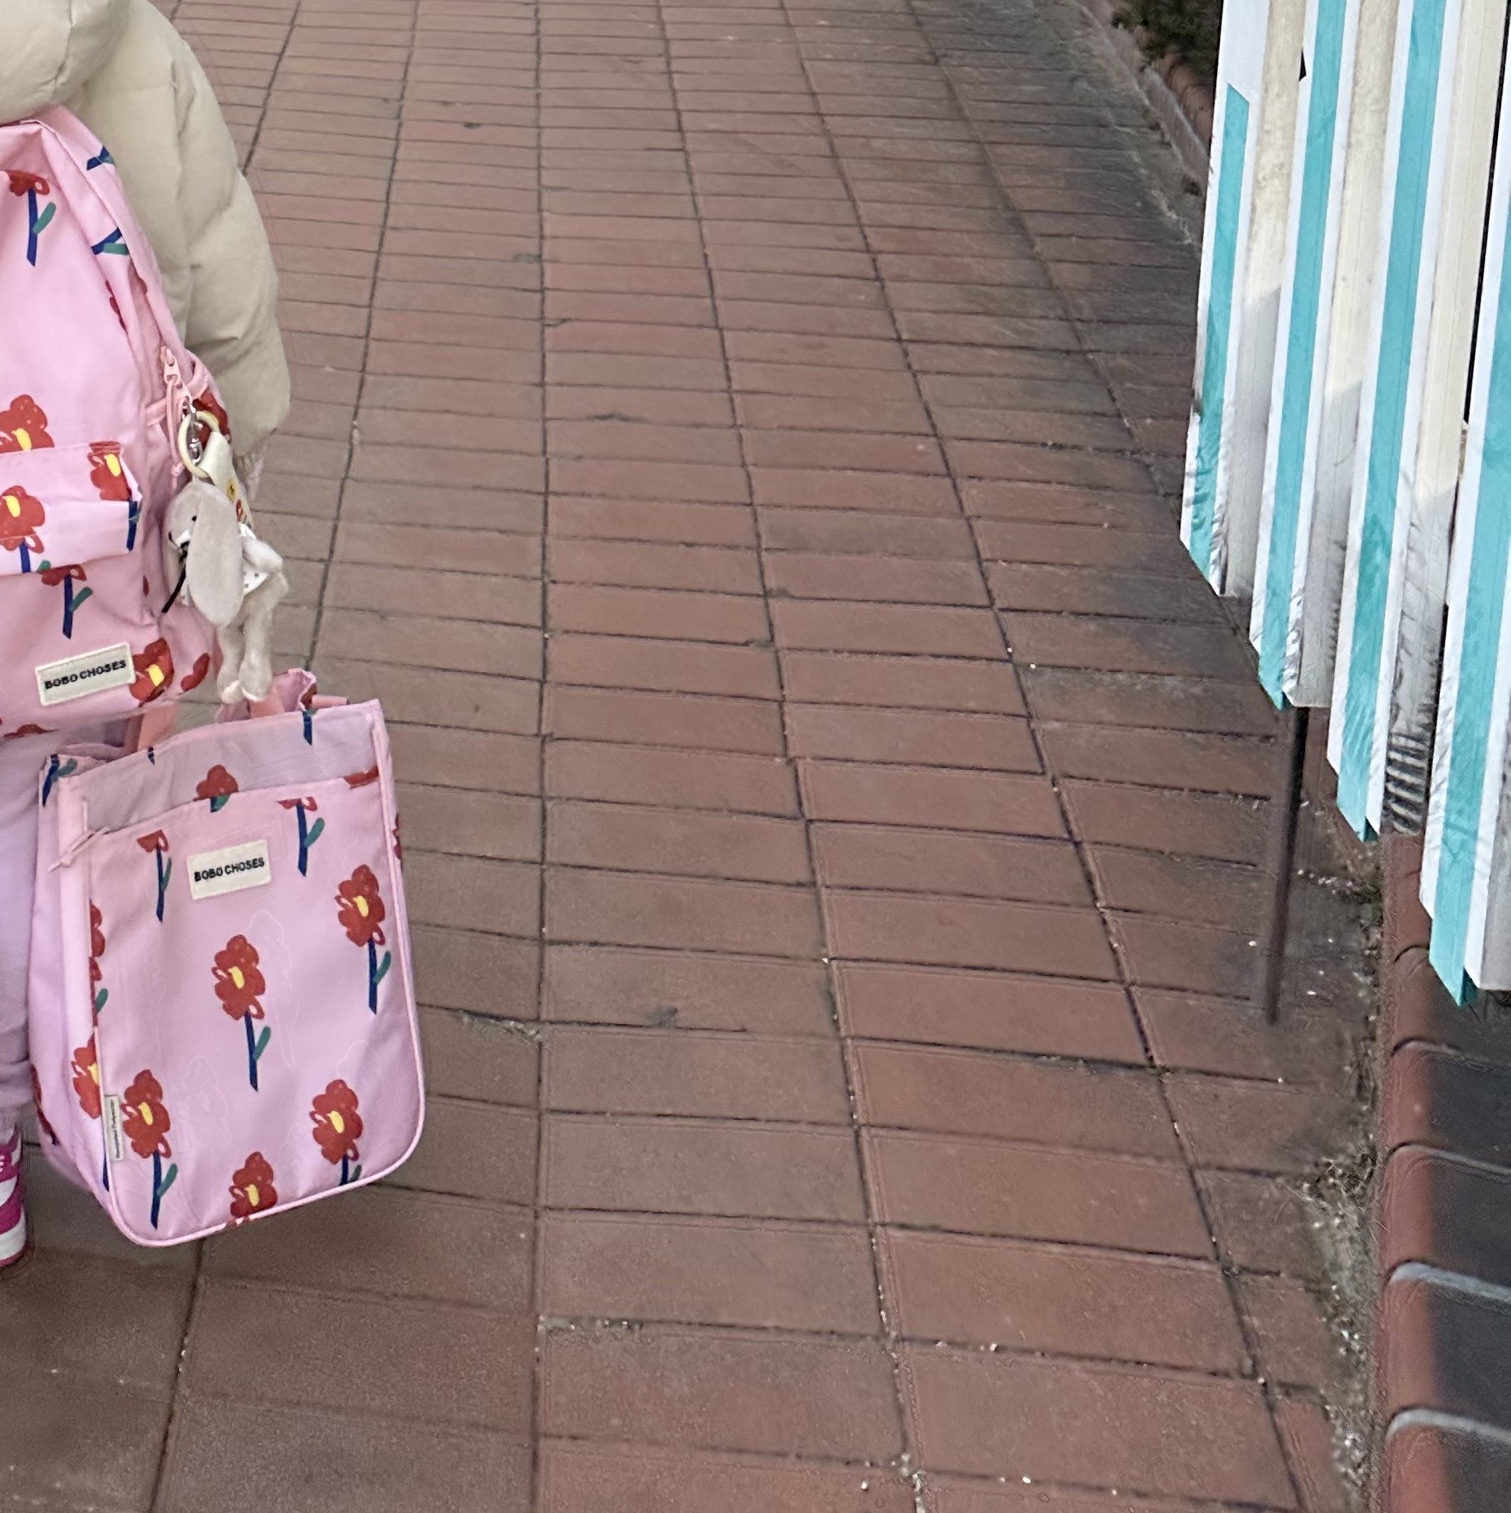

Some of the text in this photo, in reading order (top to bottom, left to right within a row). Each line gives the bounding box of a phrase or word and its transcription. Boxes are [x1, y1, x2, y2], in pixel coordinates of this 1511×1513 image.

[44, 659, 127, 690] BOBO CHOSES
[193, 857, 265, 882] BOBO CHOSES
